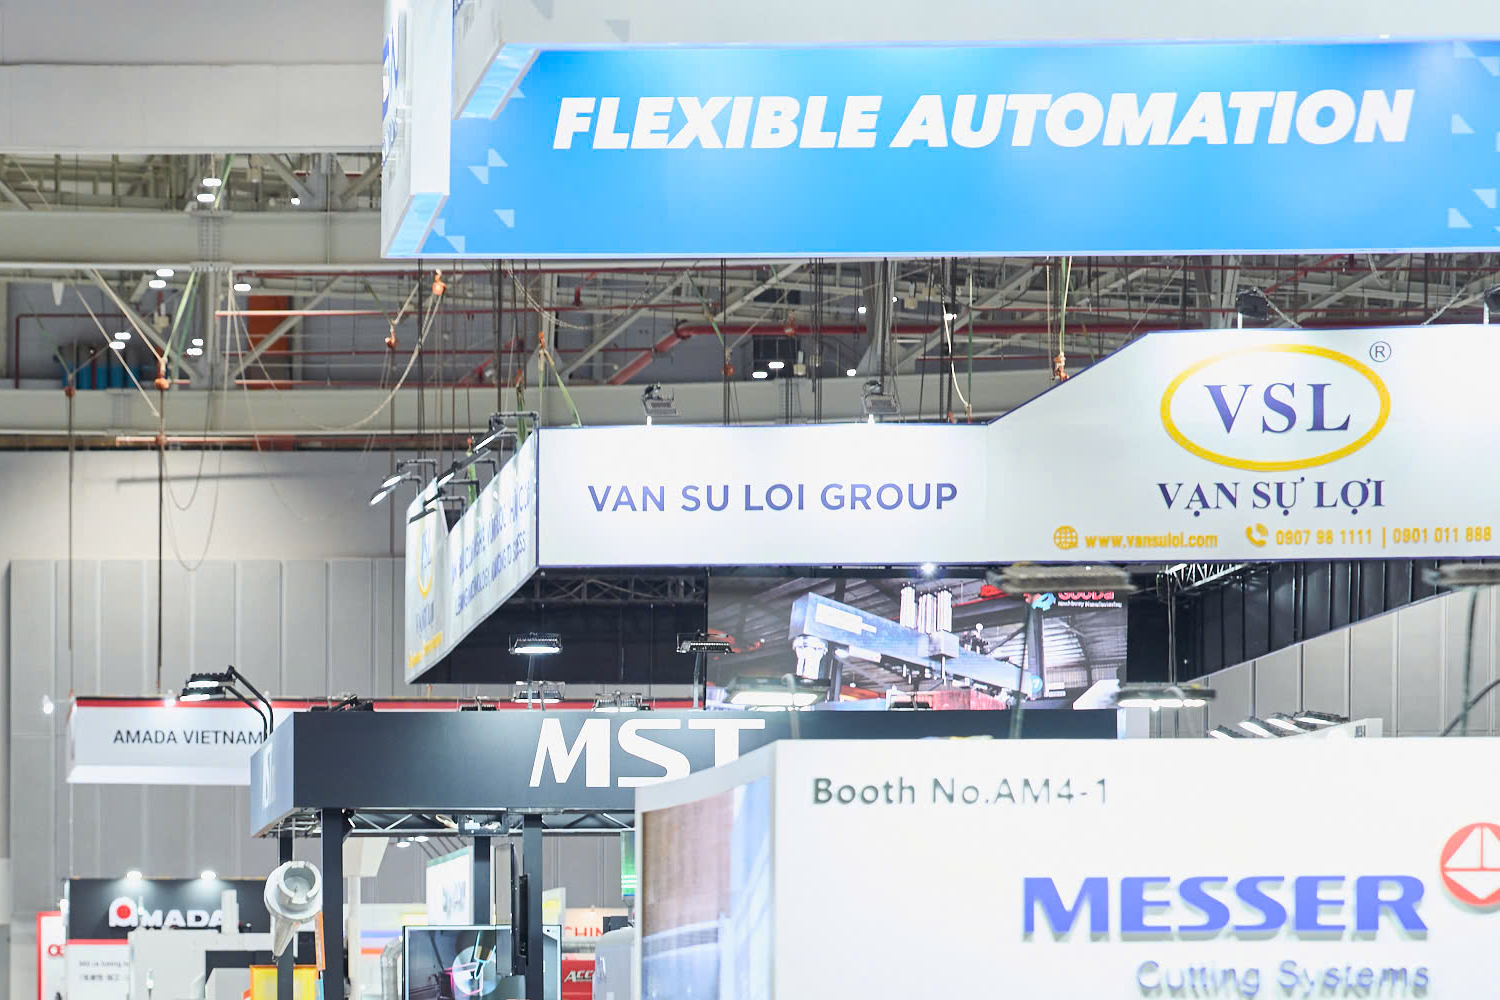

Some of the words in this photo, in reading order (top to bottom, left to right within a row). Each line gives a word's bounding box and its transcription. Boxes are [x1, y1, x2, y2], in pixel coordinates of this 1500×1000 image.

[552, 95, 883, 150] FLEXIBLE
[890, 89, 1416, 148] AUTOMATION
[1204, 382, 1352, 434] VSL
[588, 485, 666, 512] VAN
[681, 484, 730, 511] SU
[745, 483, 805, 511] LOI
[820, 482, 958, 510] GROUP
[1156, 482, 1239, 517] VẠN
[1252, 477, 1306, 516] SỰ
[1314, 478, 1386, 515] LỢI
[1275, 529, 1311, 545] 0907
[1340, 529, 1373, 545] 1111
[1392, 528, 1429, 544] 0901
[1434, 527, 1461, 543] 011
[113, 730, 177, 744] AMADA
[183, 730, 263, 745] VIETNAM
[529, 718, 766, 787] MST
[813, 776, 916, 805] Booth
[1023, 875, 1428, 933] MESSER
[1137, 960, 1260, 996] Cutting
[1278, 960, 1430, 996] Systems
